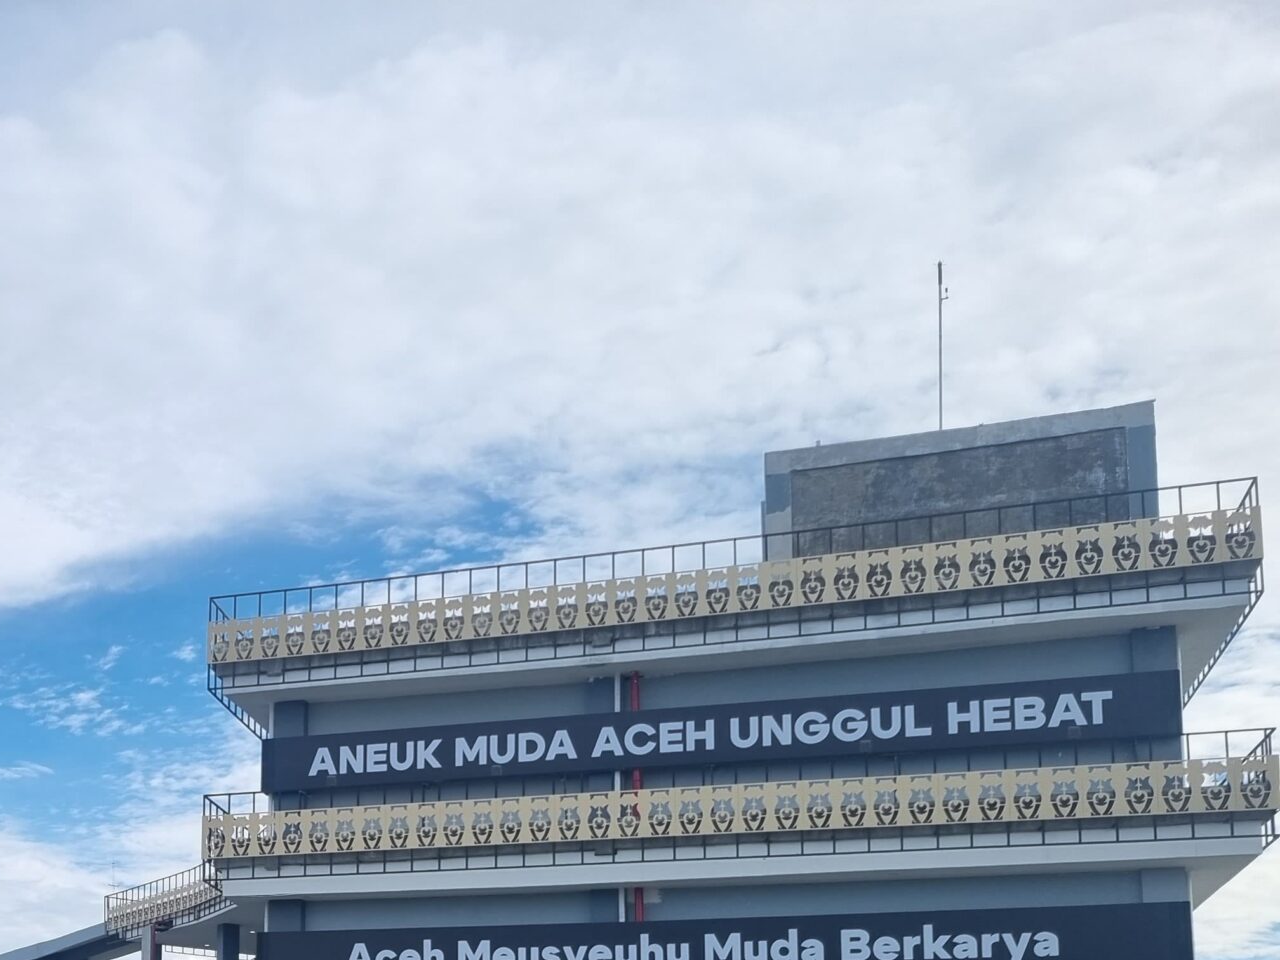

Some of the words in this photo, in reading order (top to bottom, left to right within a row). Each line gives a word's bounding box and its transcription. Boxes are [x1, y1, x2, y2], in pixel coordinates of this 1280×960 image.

[308, 738, 442, 777] ANEUK
[455, 729, 578, 767] MUDA
[591, 719, 715, 758] ACEH
[730, 704, 932, 749] UNGGUL
[947, 690, 1113, 735] HEBAT
